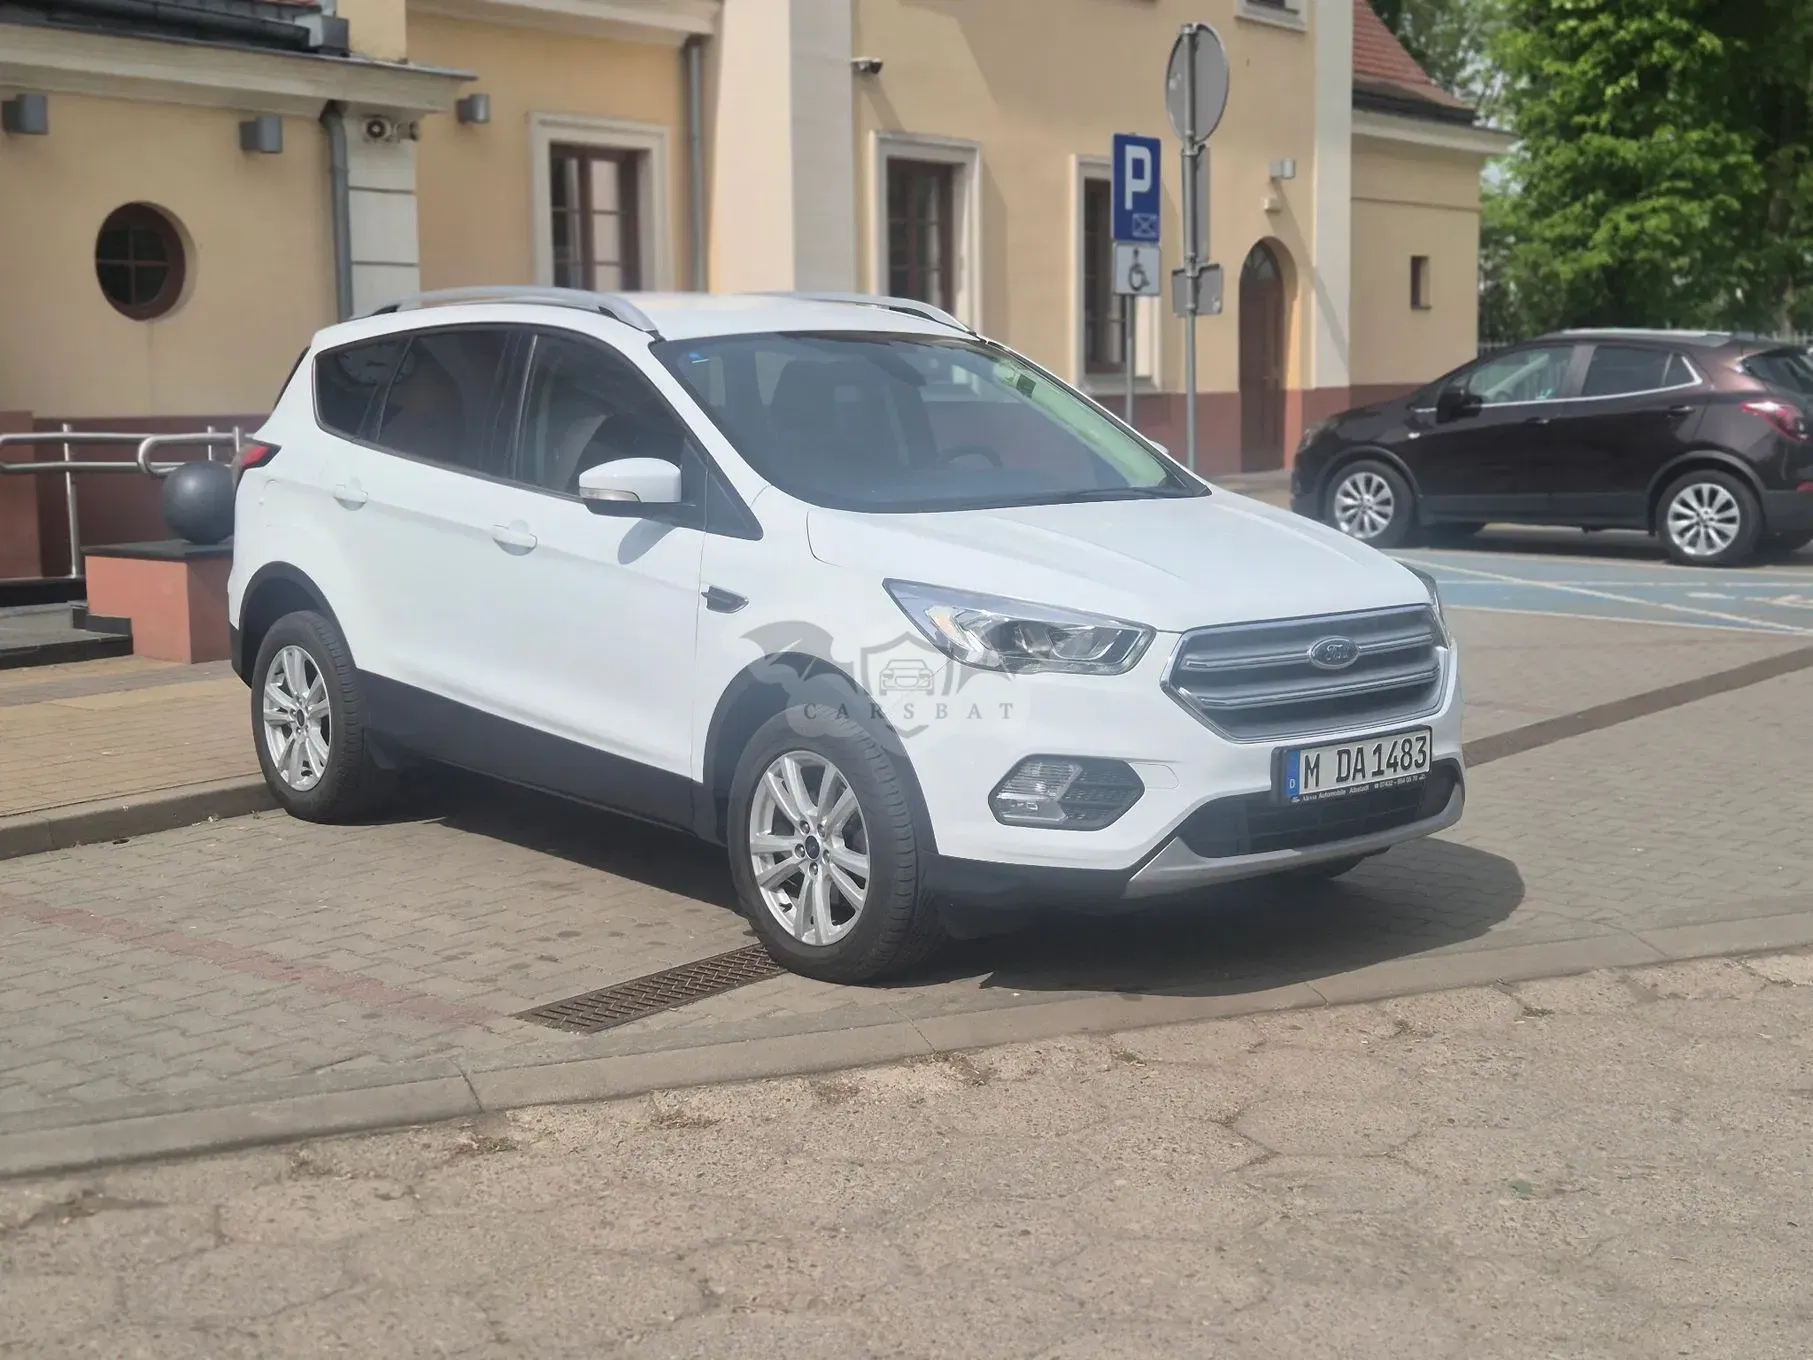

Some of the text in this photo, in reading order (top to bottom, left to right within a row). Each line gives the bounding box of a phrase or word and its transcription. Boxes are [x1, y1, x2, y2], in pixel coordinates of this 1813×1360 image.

[1125, 144, 1152, 210] P
[1289, 778, 1296, 789] D
[1303, 753, 1320, 789] M
